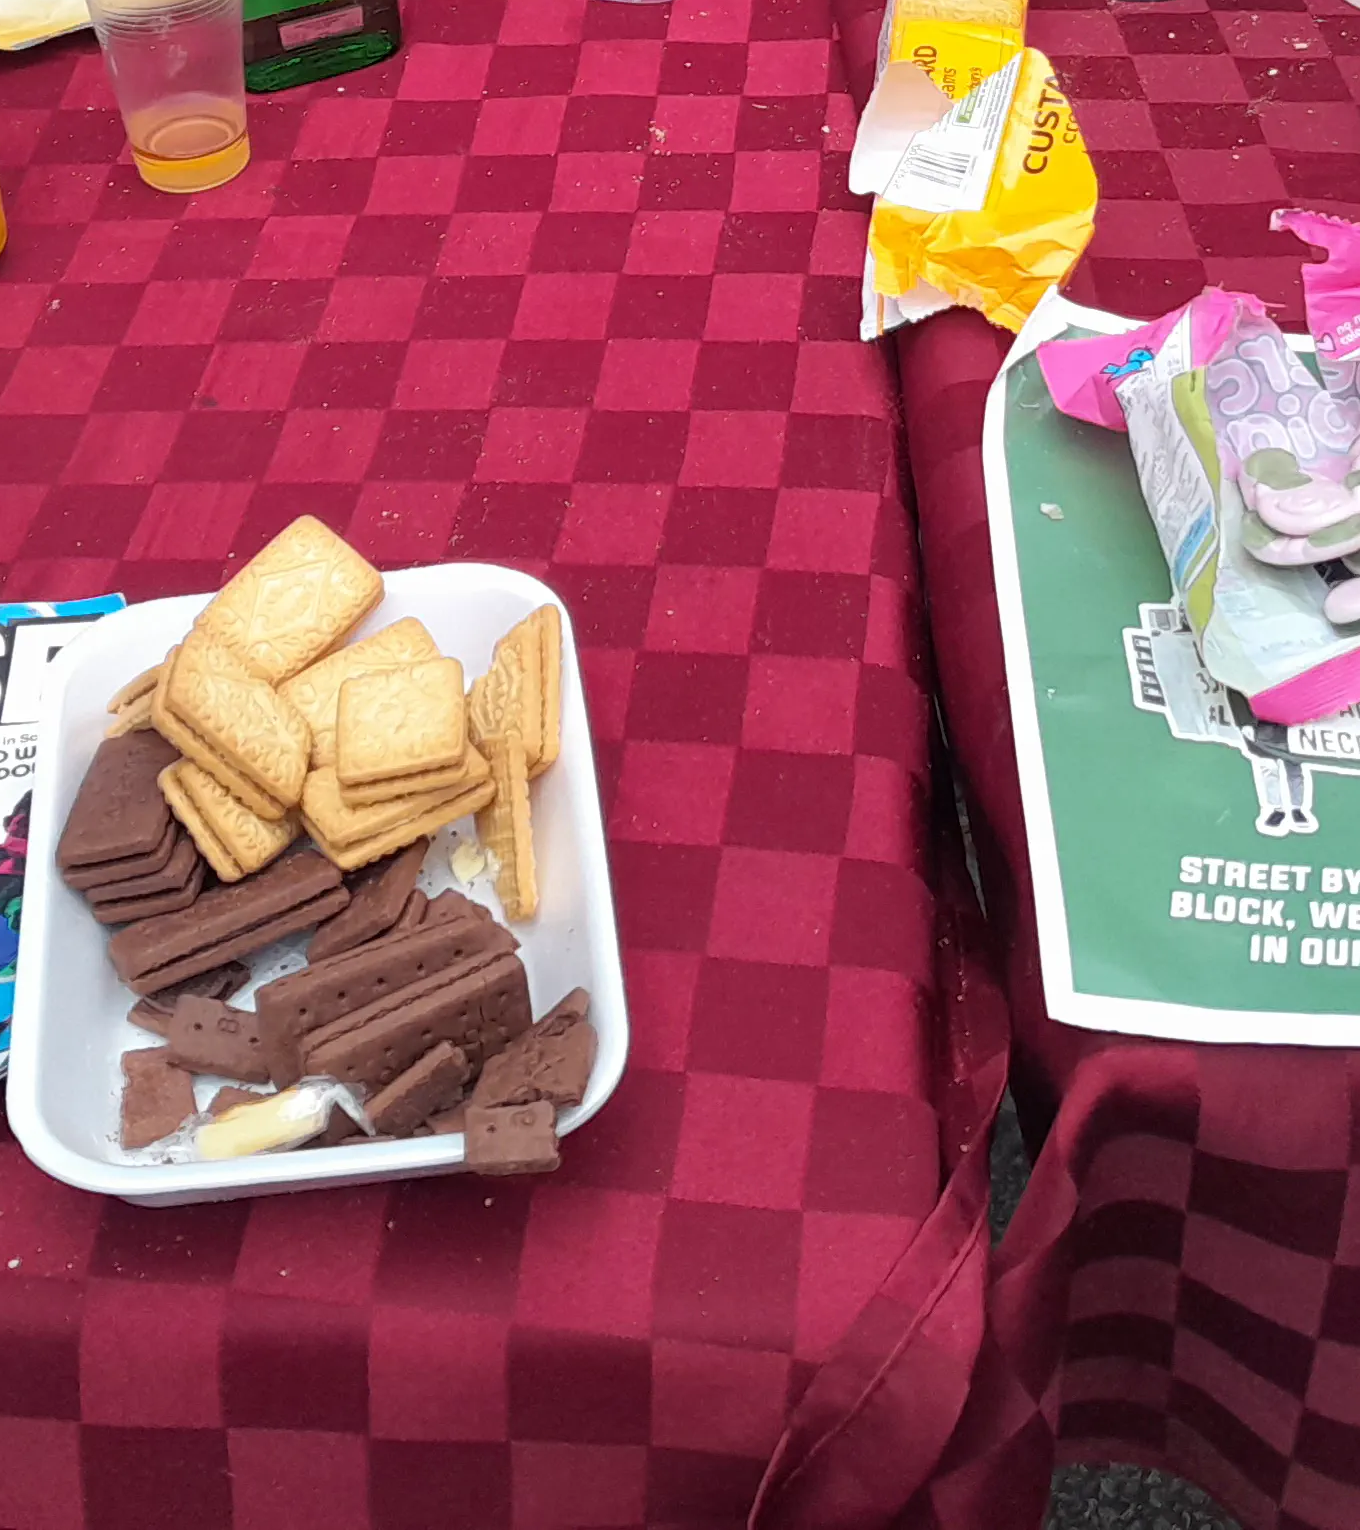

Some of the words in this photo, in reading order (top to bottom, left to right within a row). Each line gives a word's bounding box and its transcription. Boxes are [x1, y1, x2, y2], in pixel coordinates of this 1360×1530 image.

[2, 735, 16, 746] in
[1179, 856, 1311, 893] STREET
[1170, 891, 1297, 931] BLOCK,
[1250, 935, 1289, 965] IN
